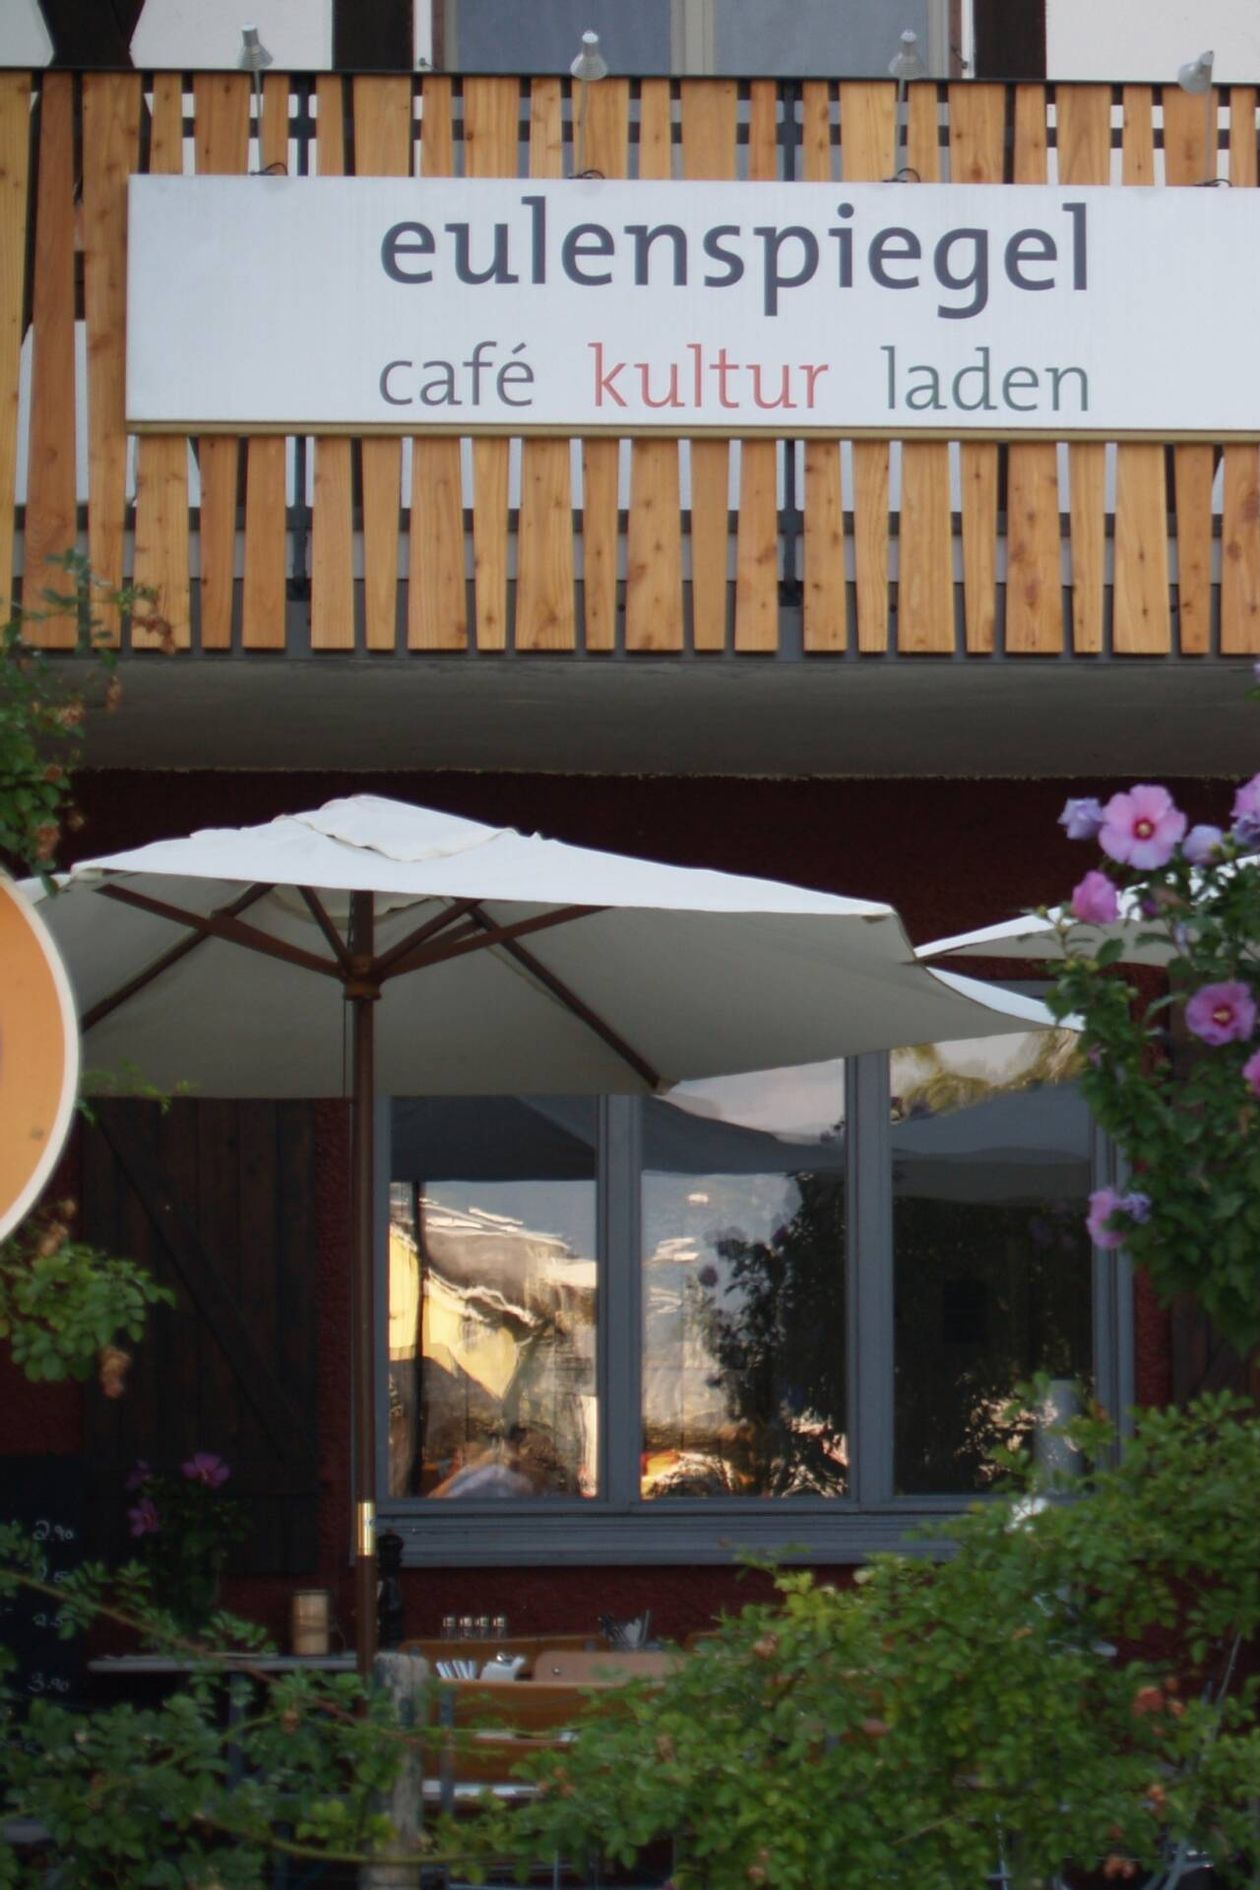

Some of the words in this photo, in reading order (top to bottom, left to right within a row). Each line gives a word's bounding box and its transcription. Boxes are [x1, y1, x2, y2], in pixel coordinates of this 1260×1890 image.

[380, 196, 1088, 319] eulenspiegel
[379, 340, 535, 406] café
[588, 342, 829, 409] kultur
[880, 346, 1088, 411] laden
